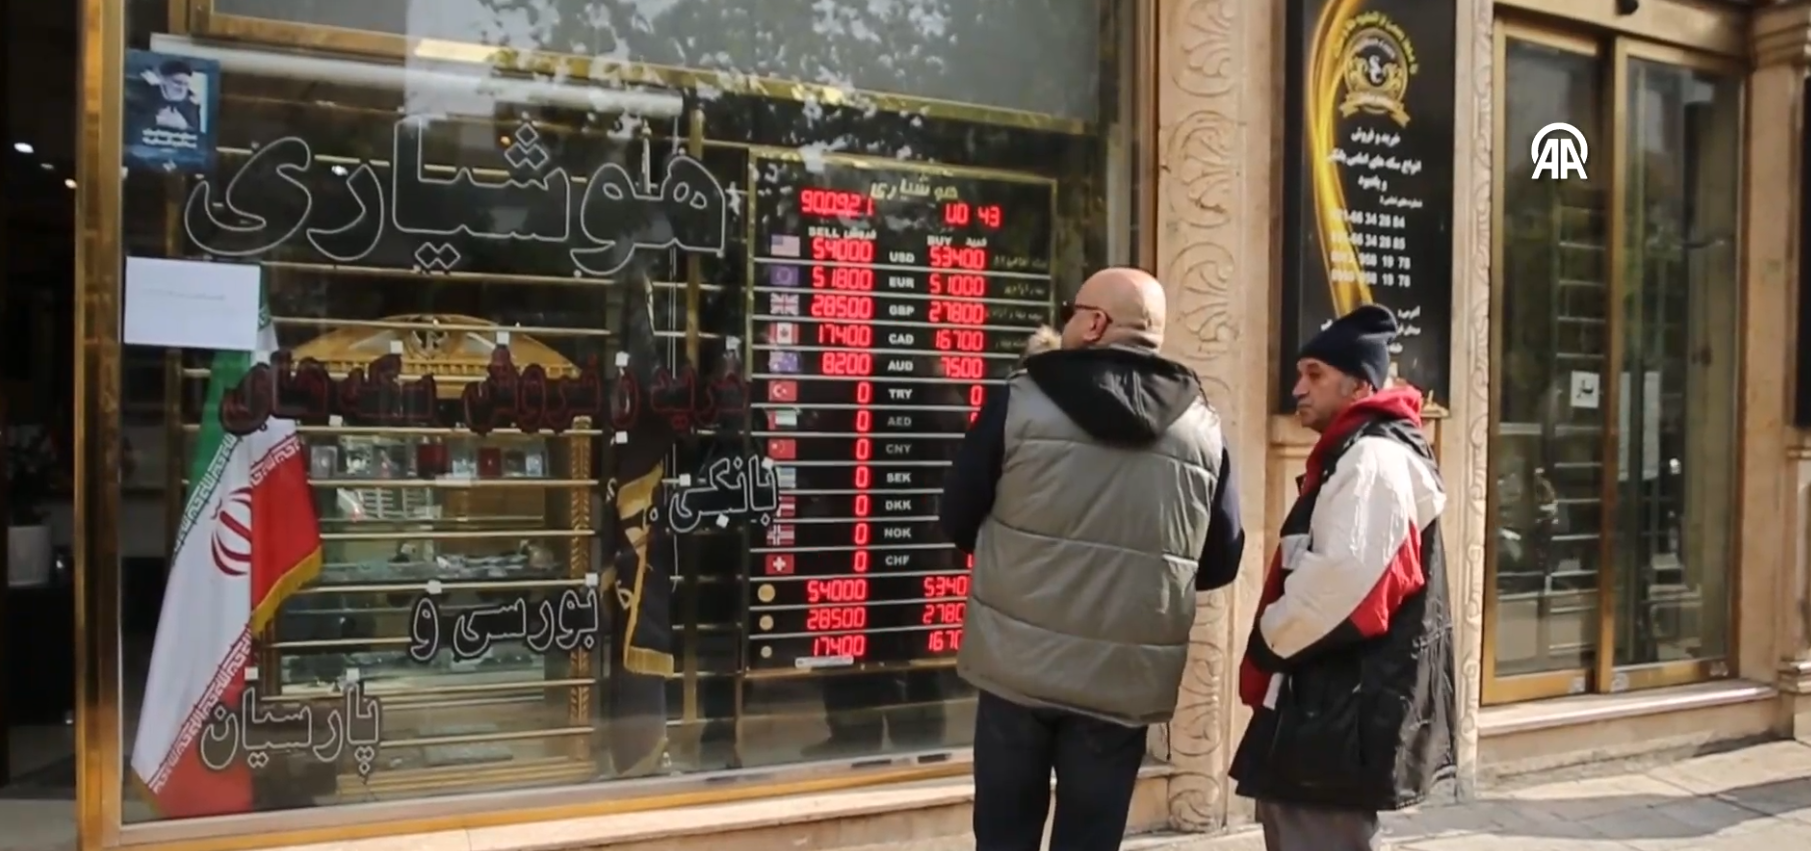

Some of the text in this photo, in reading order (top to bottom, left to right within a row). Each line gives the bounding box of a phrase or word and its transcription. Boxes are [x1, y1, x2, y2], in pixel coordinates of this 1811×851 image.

[184, 114, 727, 276] هوشیاری
[977, 205, 1001, 228] 43
[811, 238, 874, 263] 54000
[926, 234, 954, 247] BUY
[889, 251, 915, 264] USD
[929, 244, 986, 270] 53400
[812, 264, 874, 291] 51800
[889, 276, 915, 289] EUR
[928, 272, 985, 296] 51000
[810, 293, 873, 319] 28500
[889, 304, 915, 317] GBP
[928, 300, 985, 325] 27800
[818, 323, 872, 347] 17400
[888, 333, 915, 346] CAD
[935, 329, 985, 351] 16700
[822, 352, 871, 375] 8200
[887, 360, 914, 372] AUD
[941, 357, 984, 379] 7500
[857, 381, 870, 404] 0
[888, 388, 913, 399] TRY
[970, 384, 983, 406] 0
[857, 409, 869, 432] 0
[887, 416, 912, 427] AED
[856, 438, 869, 460] 0
[885, 443, 912, 454] CNY
[855, 465, 868, 488] 0
[855, 494, 868, 516] 0
[885, 500, 912, 511] DKK
[854, 522, 868, 545] 0
[884, 528, 912, 538] NOK
[854, 550, 867, 572] 0
[885, 555, 910, 565] CHF
[807, 579, 867, 602] 54000
[410, 596, 440, 660] و
[452, 579, 599, 656] بورسی
[807, 606, 866, 631] 28500
[813, 635, 865, 657] 17400
[199, 680, 382, 776] پارسیان
